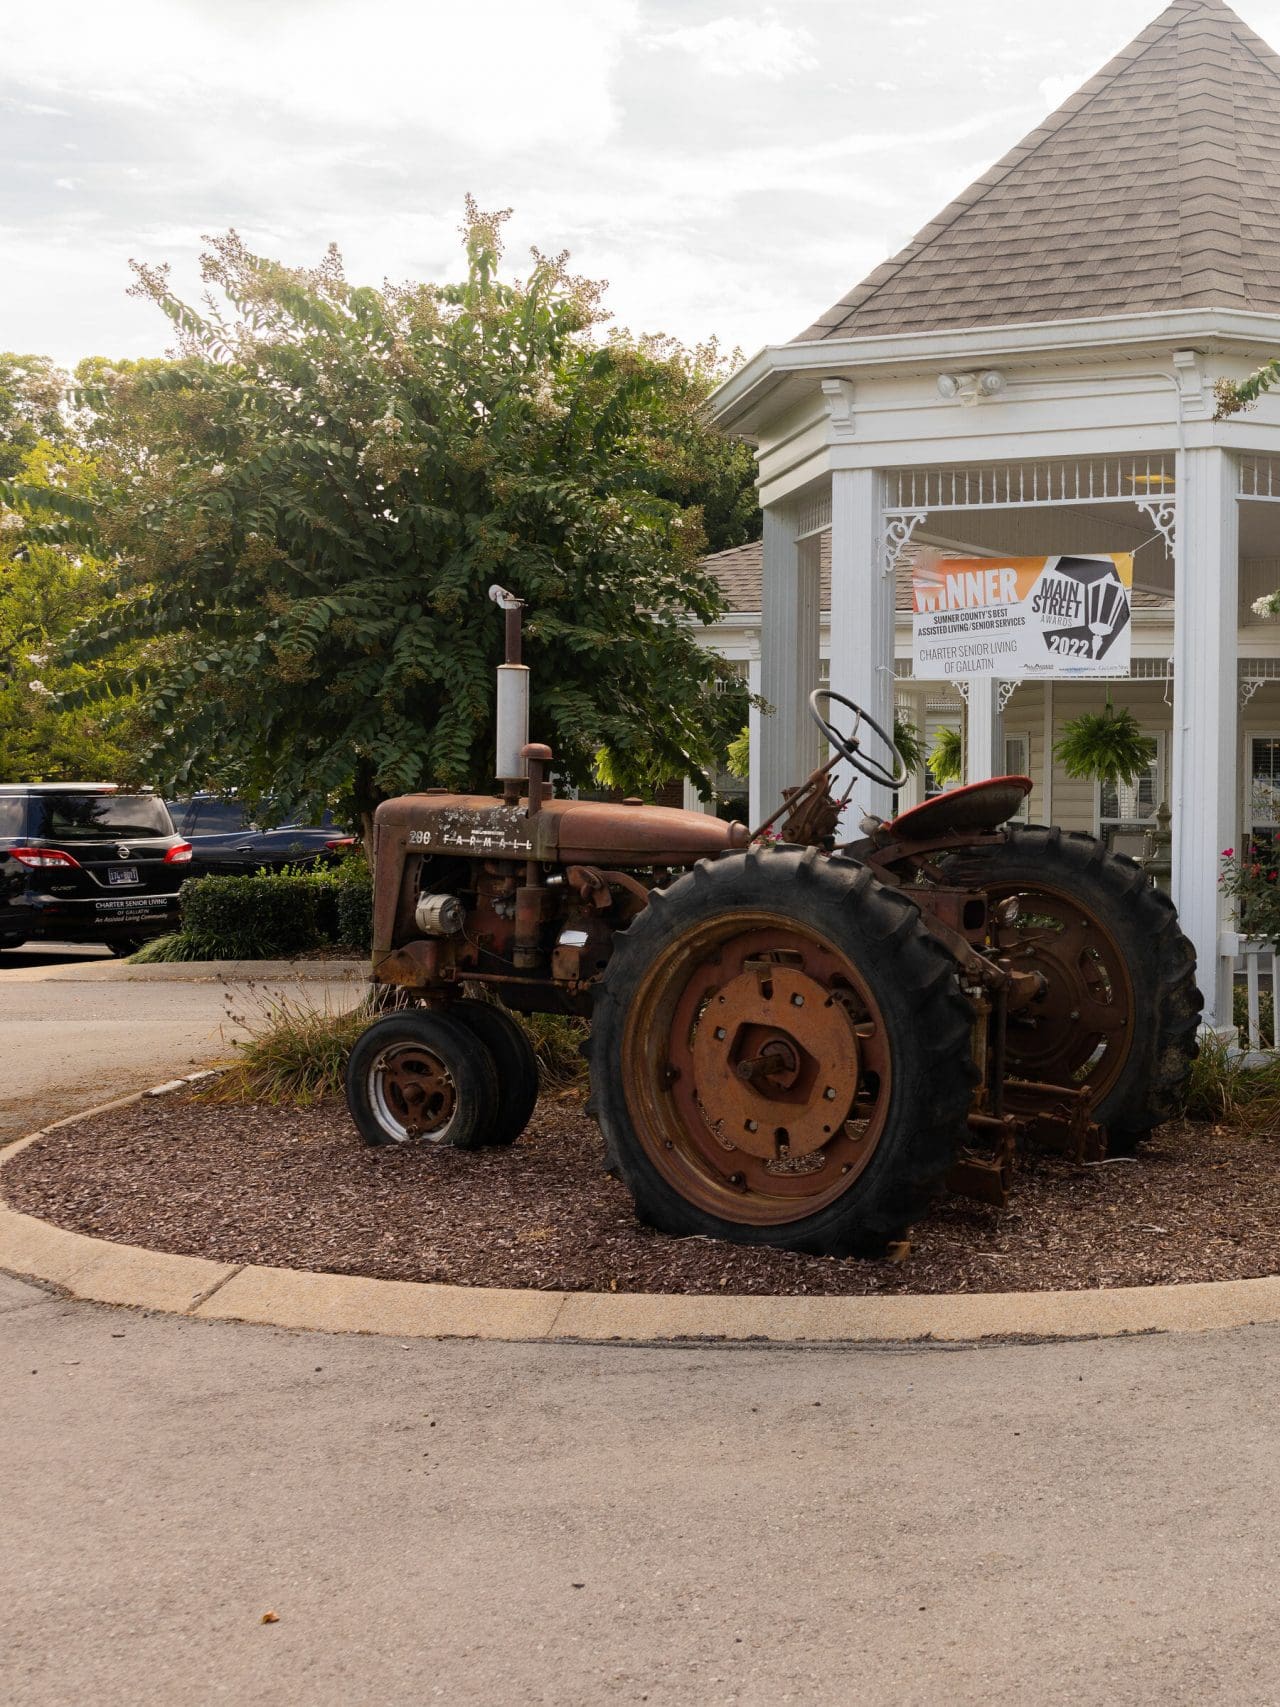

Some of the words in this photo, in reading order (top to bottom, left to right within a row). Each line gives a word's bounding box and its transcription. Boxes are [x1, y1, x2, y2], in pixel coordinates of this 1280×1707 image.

[914, 568, 1019, 613] WINNER
[1040, 578, 1080, 602] MAIN
[1031, 594, 1082, 618] STREET
[933, 613, 959, 625] SUMNER
[960, 610, 992, 622] COUNTY'S
[992, 608, 1008, 618] BEST
[1040, 615, 1073, 627] AWARDS
[918, 625, 947, 637] ASSISTED
[995, 617, 1026, 628] SERVICES
[919, 646, 957, 661] CHARTER
[958, 643, 989, 657] SENIOR
[990, 640, 1018, 654] LIVING
[1048, 635, 1090, 658] 2022
[944, 661, 955, 674] OF
[956, 658, 994, 673] GALLATIN
[443, 834, 533, 850] FARMALL
[95, 901, 125, 909] CHARTER
